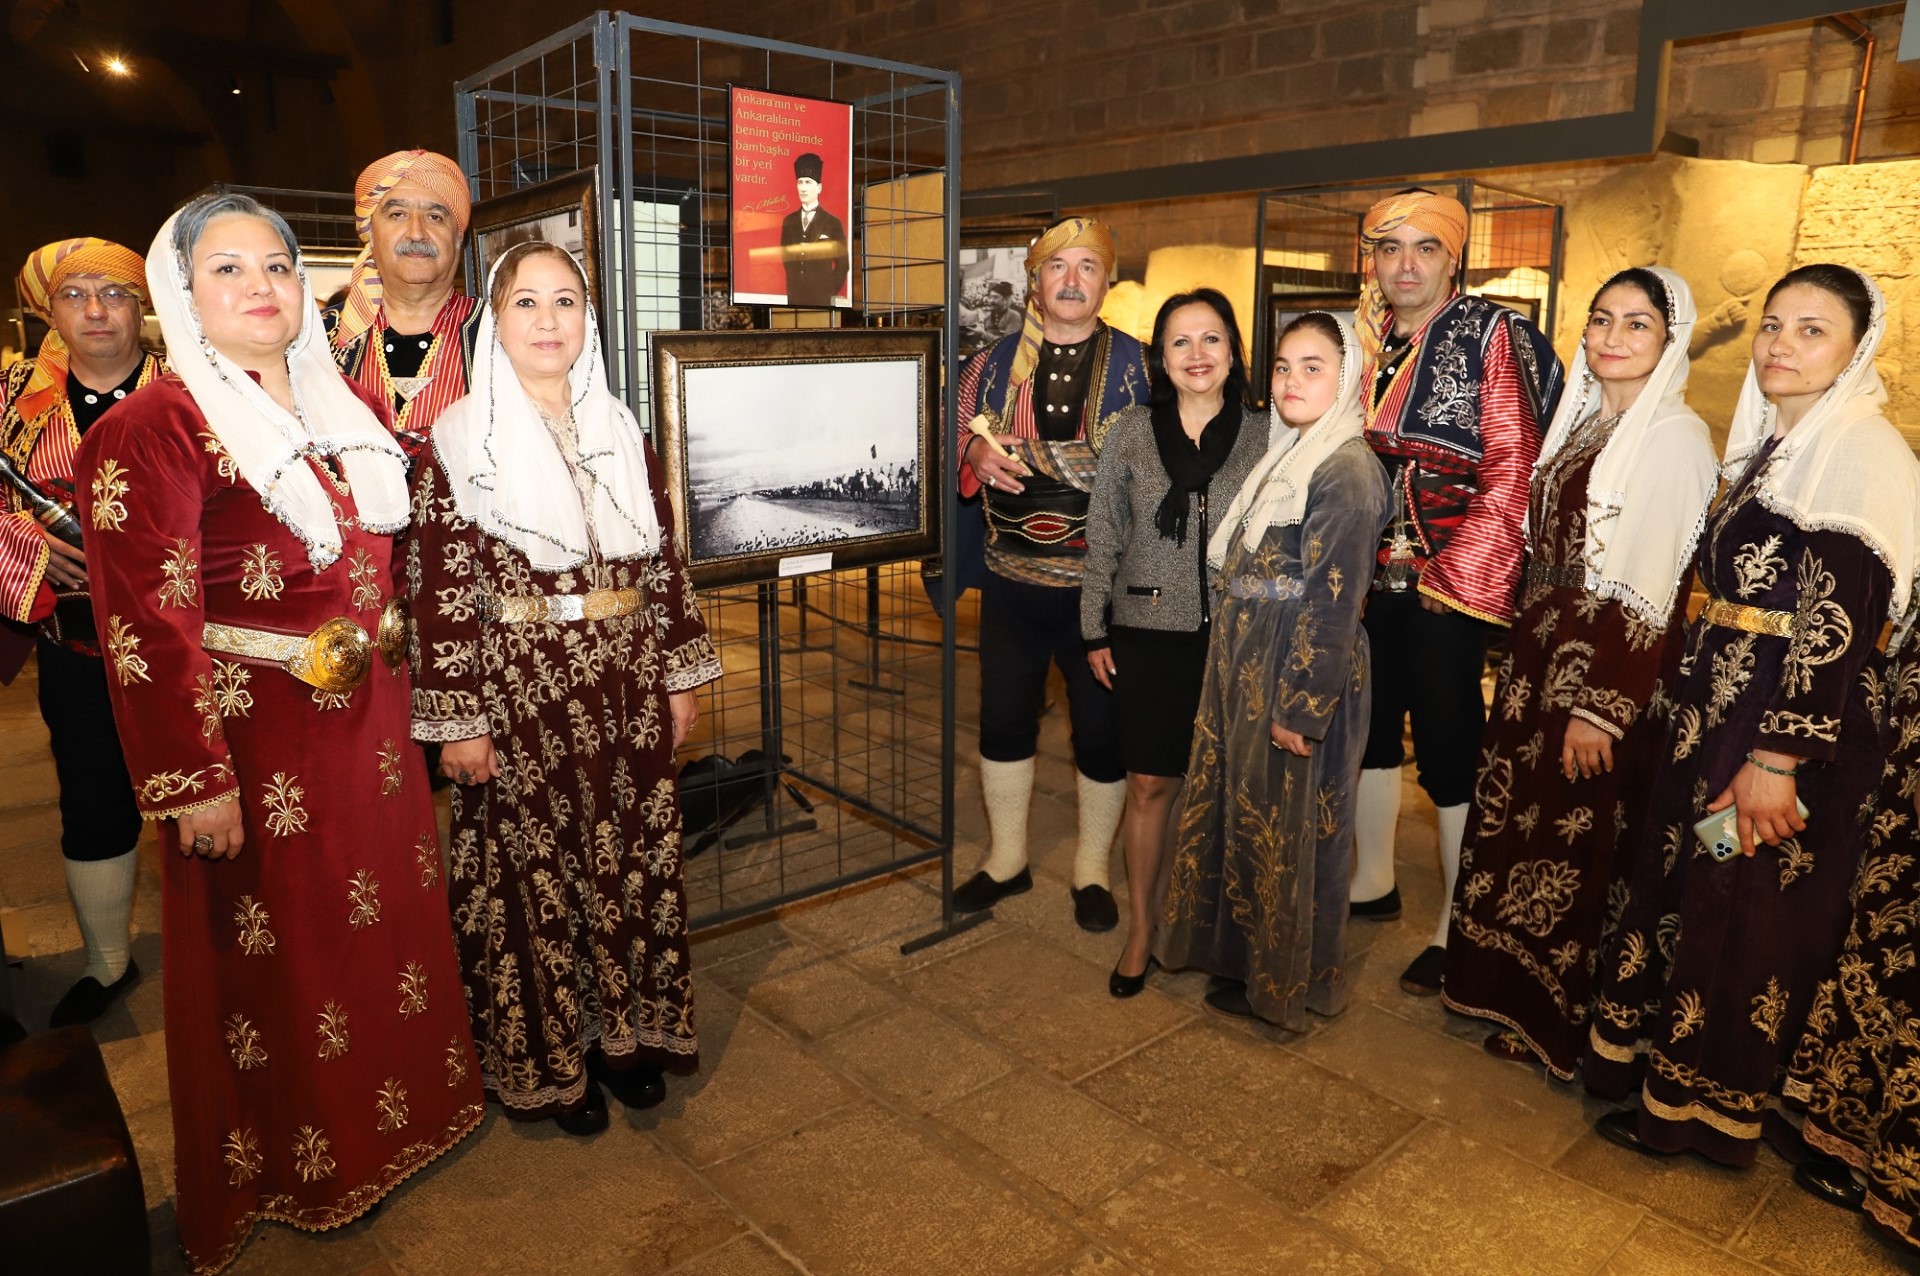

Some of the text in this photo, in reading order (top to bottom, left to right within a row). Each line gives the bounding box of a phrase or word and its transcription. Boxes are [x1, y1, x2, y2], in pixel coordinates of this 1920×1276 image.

[736, 92, 806, 112] Ankara'nın ve
[735, 108, 801, 127] Ankaralıların
[735, 124, 823, 145] benim gönlümde
[735, 140, 790, 156] bambaşka
[735, 155, 773, 171] bir yeri
[734, 173, 768, 185] vardır.
